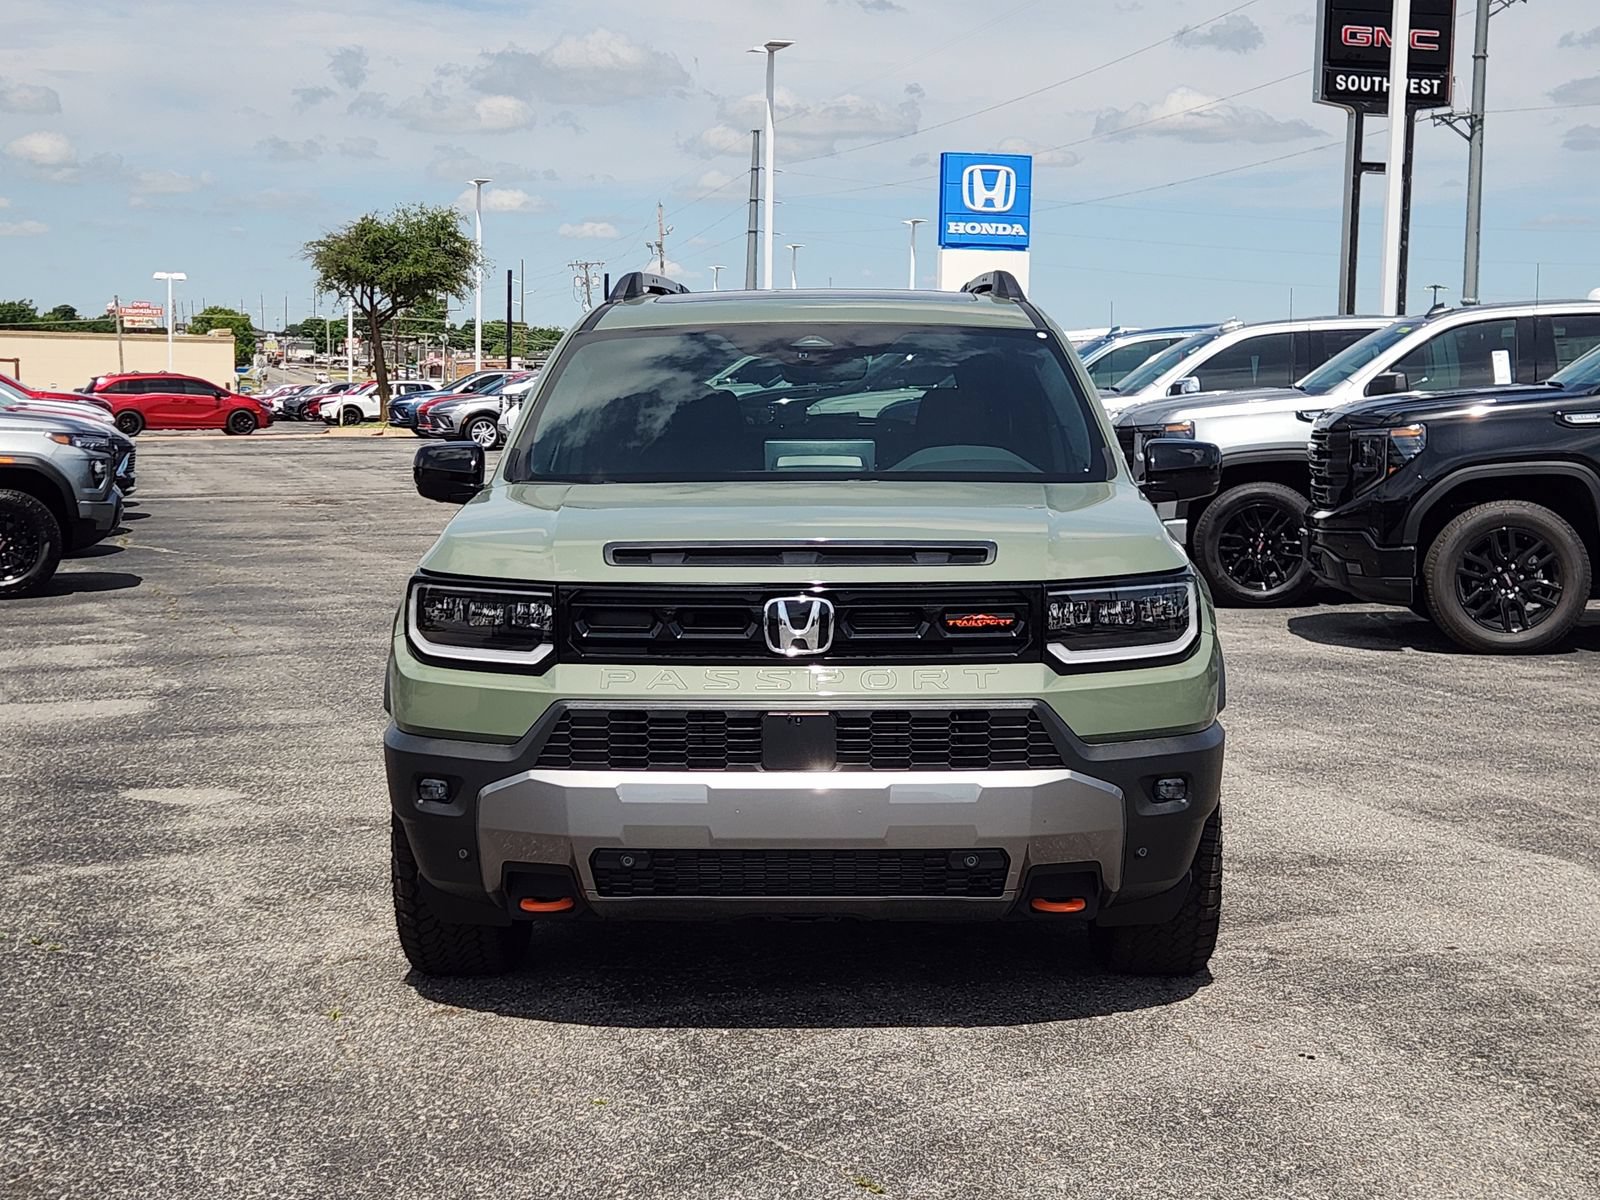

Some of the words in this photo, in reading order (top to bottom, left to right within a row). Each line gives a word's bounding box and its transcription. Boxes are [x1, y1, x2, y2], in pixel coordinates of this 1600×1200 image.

[1336, 75, 1441, 94] SOUTHEST
[947, 222, 1027, 236] HONDA
[947, 619, 1014, 627] TRAILSPORT
[600, 668, 1000, 690] PASSPORT
